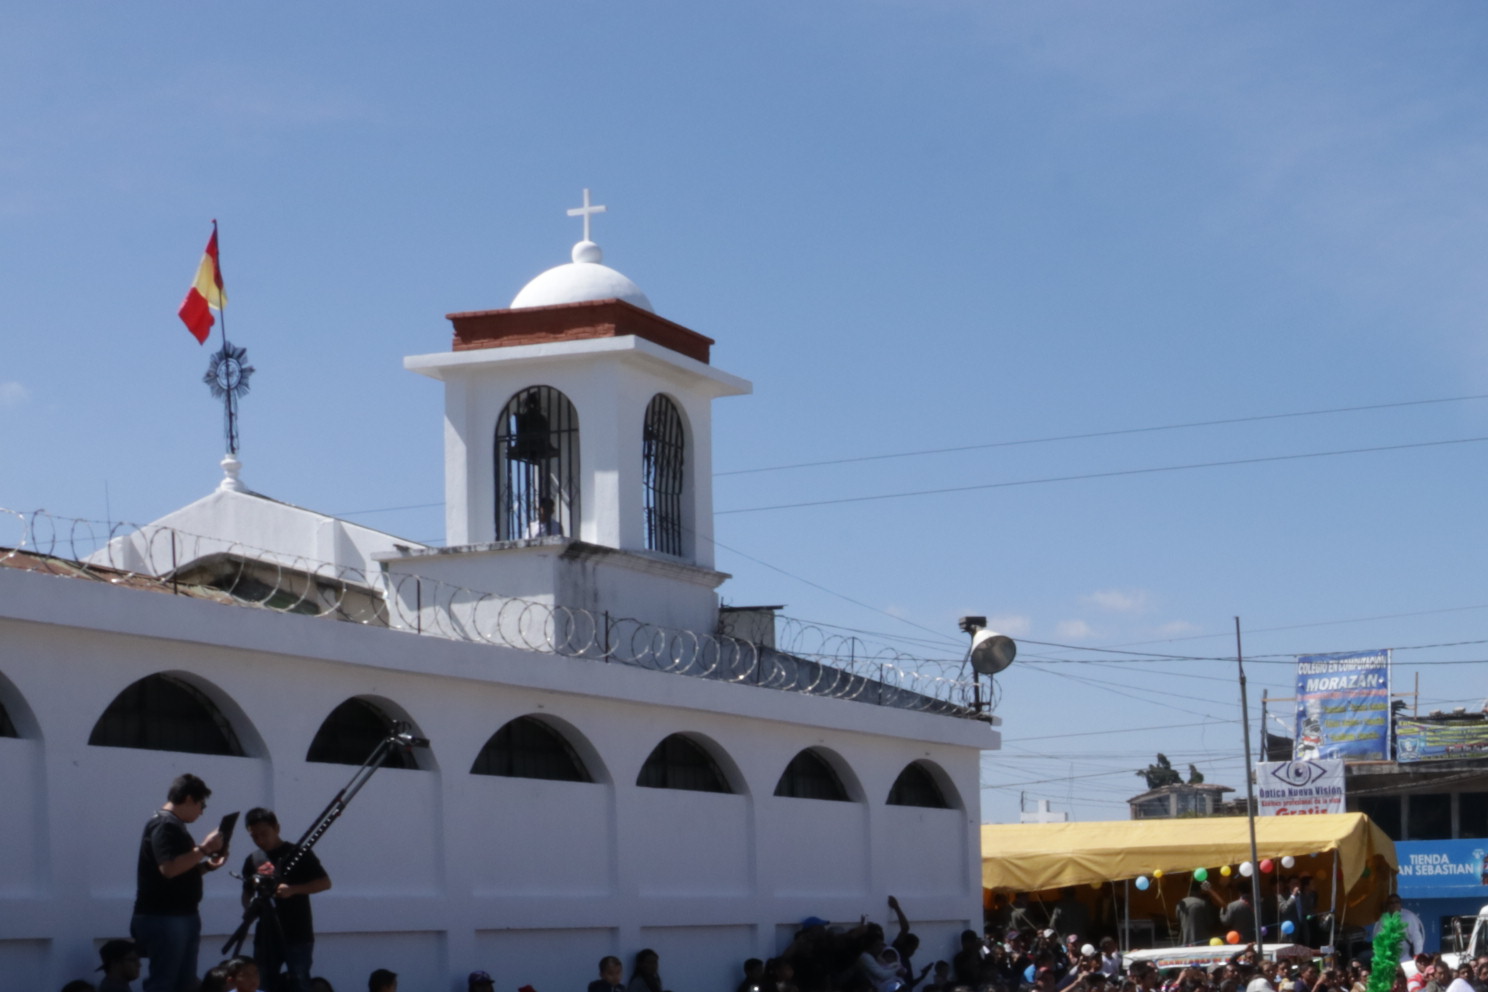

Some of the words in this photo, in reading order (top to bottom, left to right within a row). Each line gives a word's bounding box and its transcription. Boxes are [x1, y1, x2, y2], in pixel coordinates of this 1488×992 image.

[1298, 661, 1328, 675] COLEGIO
[1328, 660, 1338, 672] EN
[1305, 670, 1379, 692] MORAZÁN
[1287, 786, 1314, 798] Nueva
[1314, 784, 1342, 796] Visión
[1408, 853, 1450, 865] TIENDA
[1398, 864, 1413, 876] AN
[1415, 863, 1475, 876] SEBASTIAN
